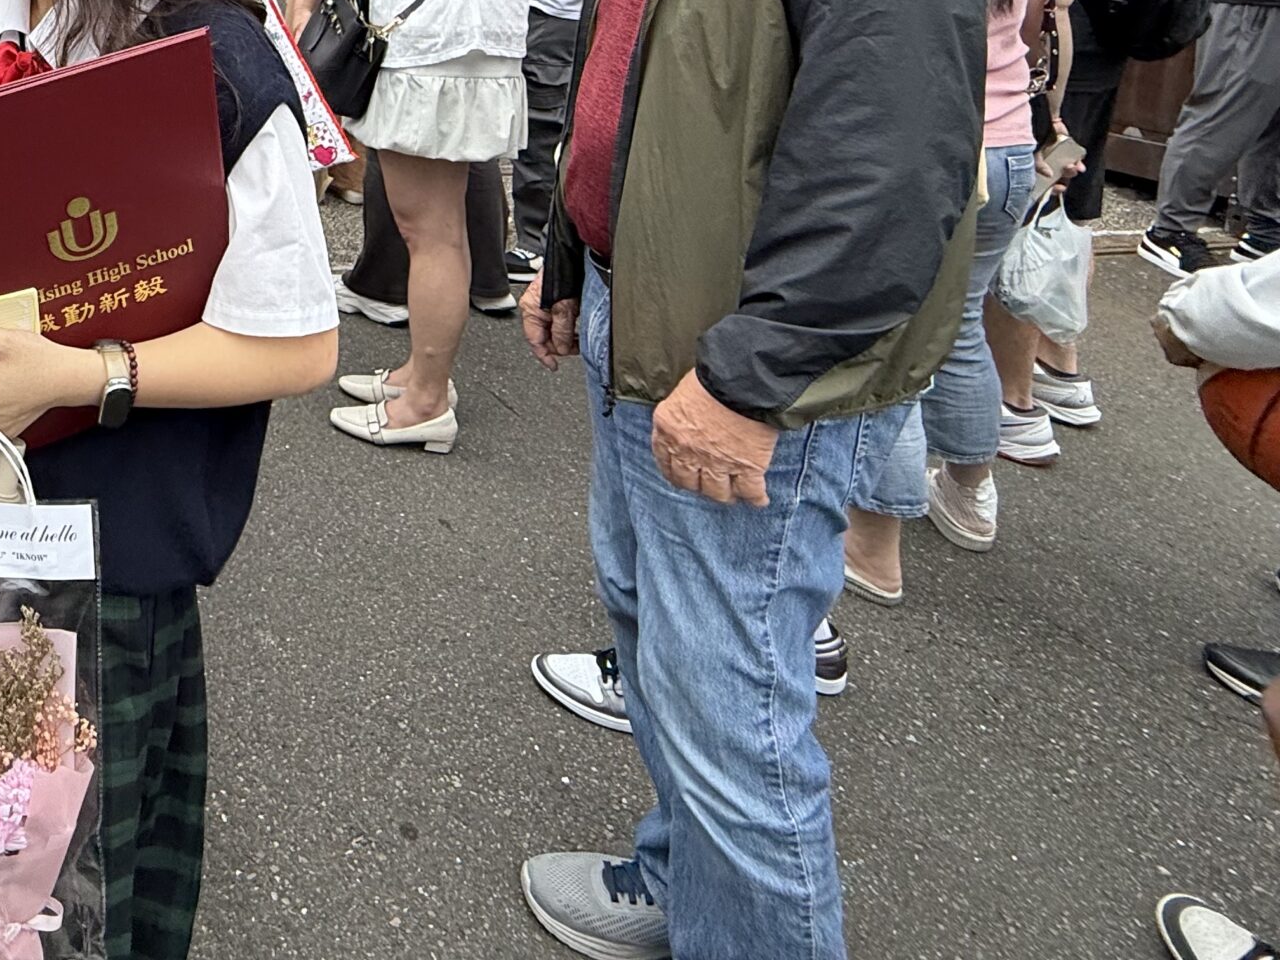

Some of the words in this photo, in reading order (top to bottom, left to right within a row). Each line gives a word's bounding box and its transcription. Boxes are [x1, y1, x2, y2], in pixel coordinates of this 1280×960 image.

[87, 261, 132, 288] High
[135, 238, 195, 271] School
[20, 525, 39, 542] at
[38, 524, 78, 544] hello
